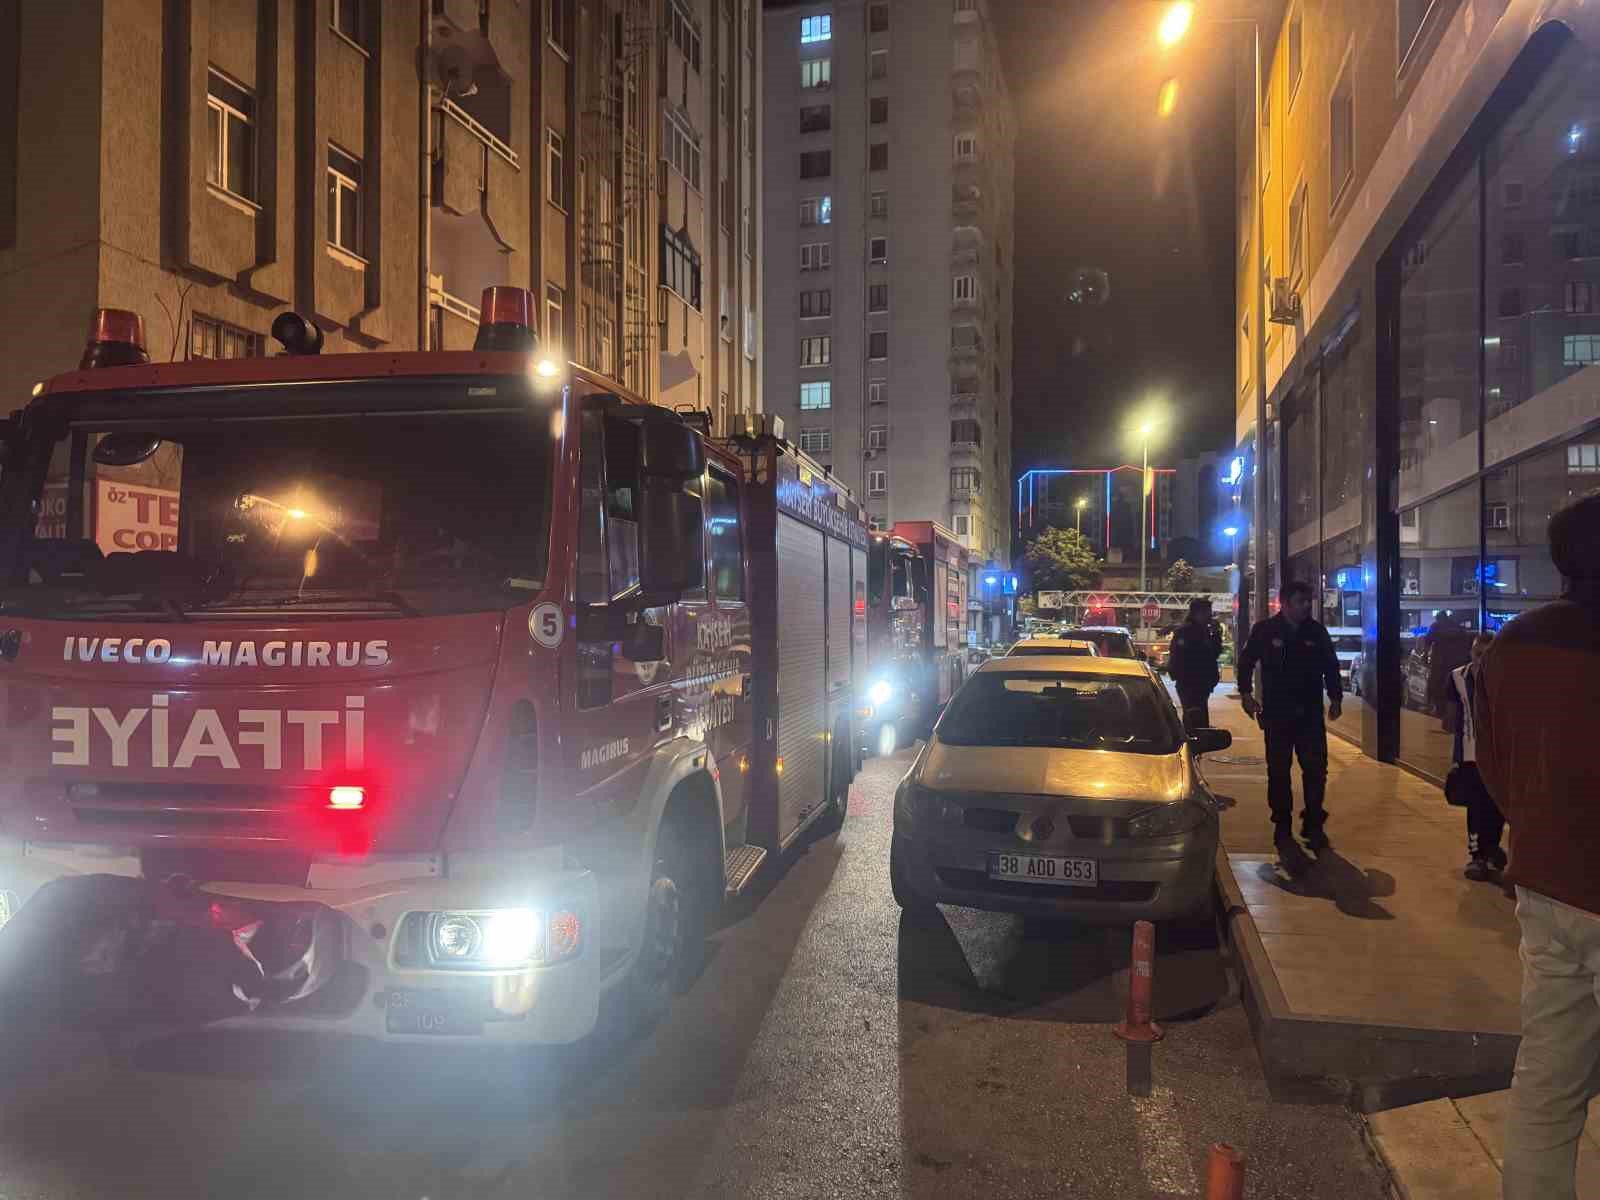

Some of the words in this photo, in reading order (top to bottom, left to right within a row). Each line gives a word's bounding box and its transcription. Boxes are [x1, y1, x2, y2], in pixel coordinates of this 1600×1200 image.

[107, 487, 127, 504] ÖZ
[542, 612, 558, 638] 5
[63, 636, 172, 664] IVECO
[201, 639, 390, 667] MAGIRUS
[580, 736, 630, 770] MAGIRUS
[1000, 856, 1019, 874] 38
[1063, 860, 1092, 880] 653
